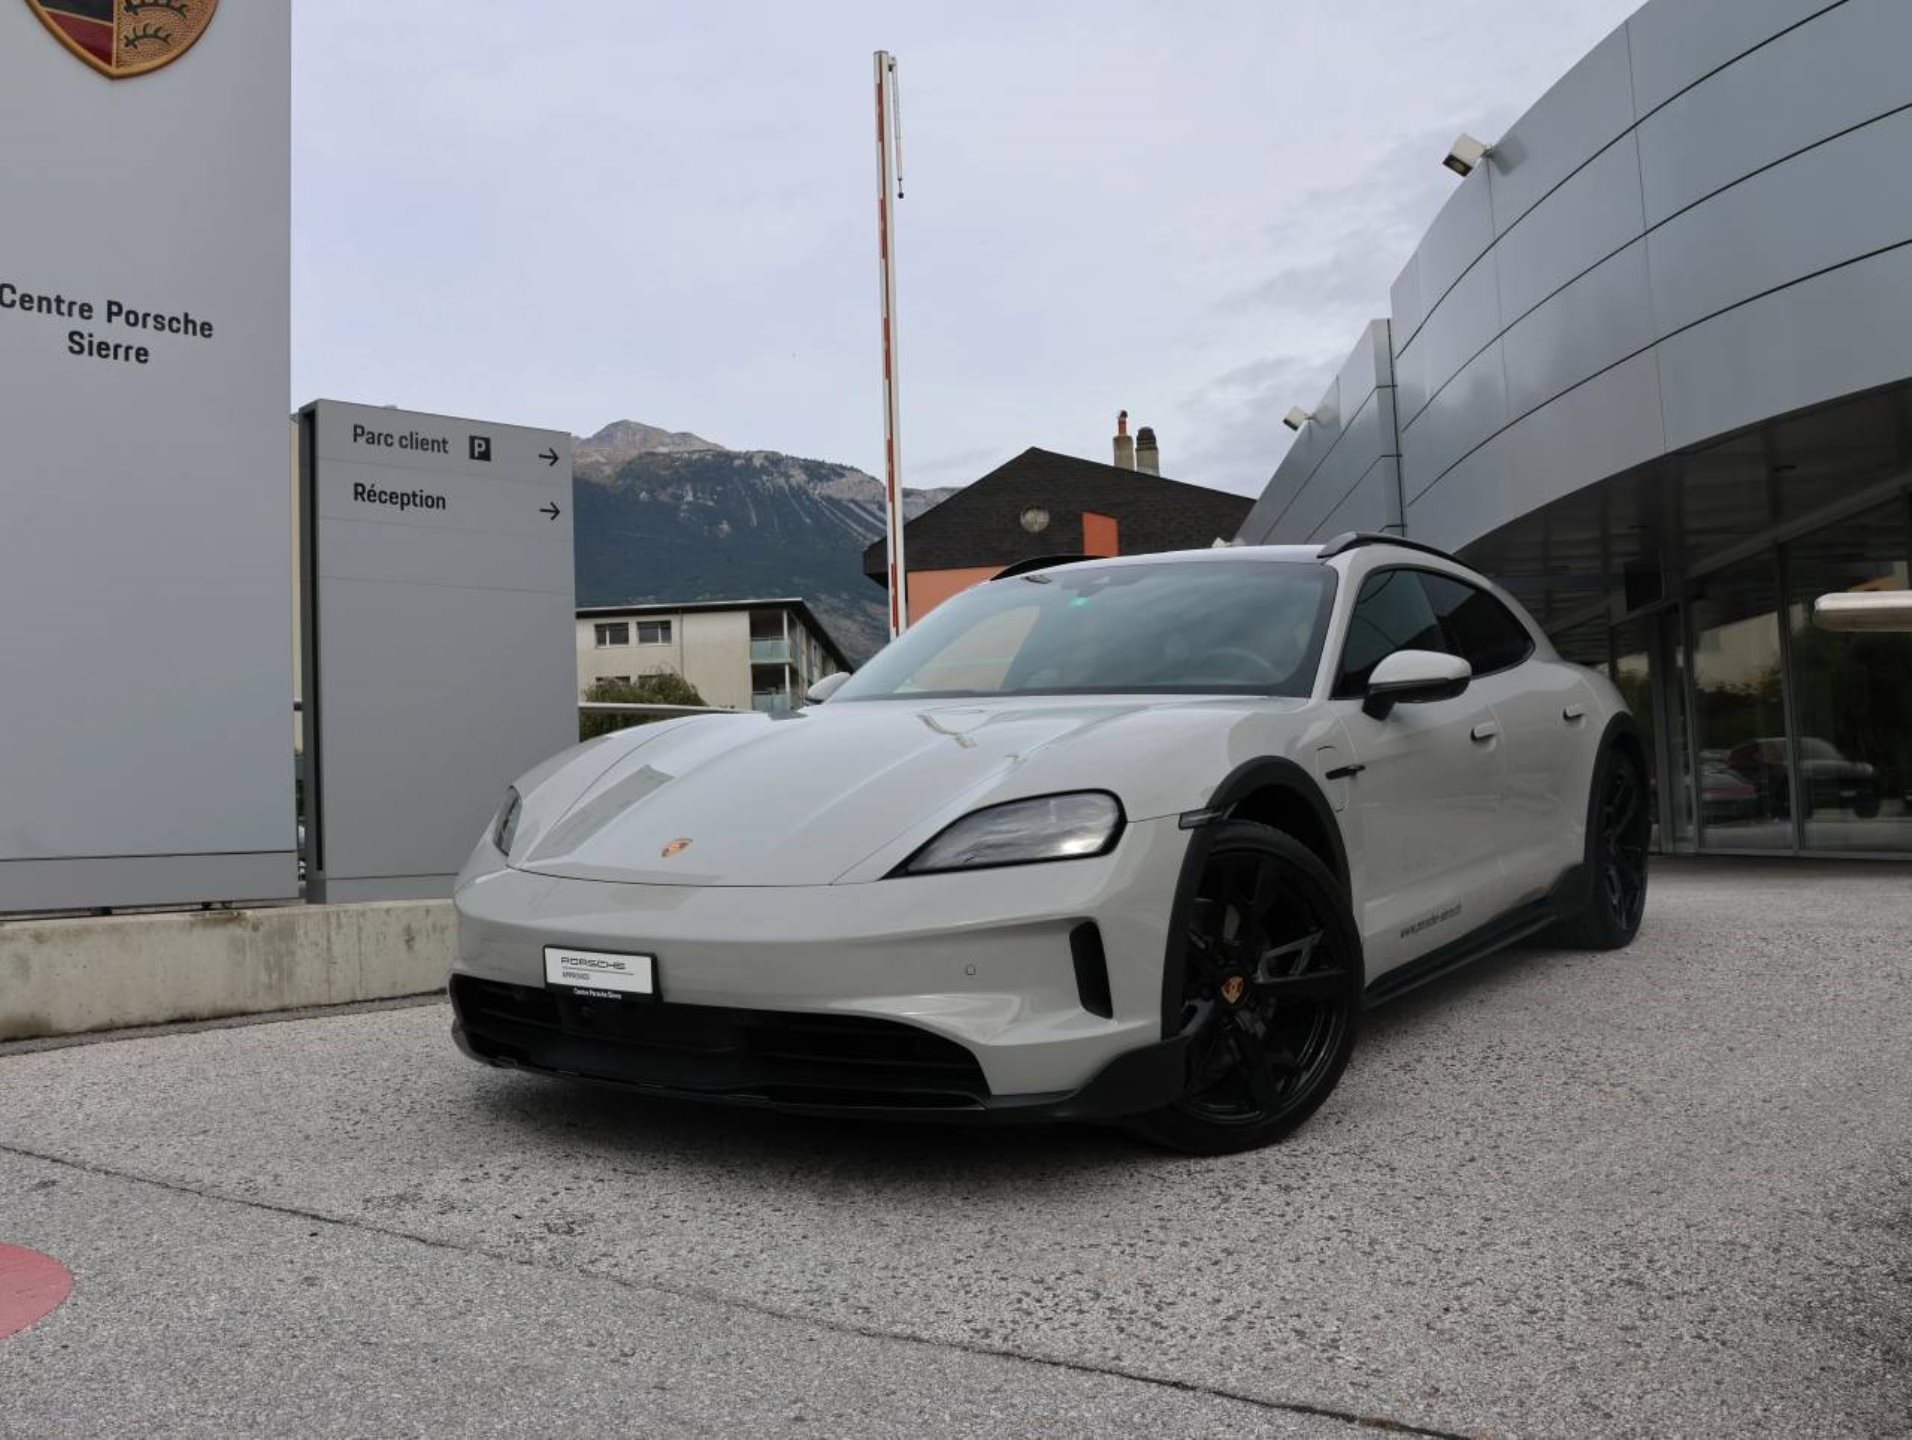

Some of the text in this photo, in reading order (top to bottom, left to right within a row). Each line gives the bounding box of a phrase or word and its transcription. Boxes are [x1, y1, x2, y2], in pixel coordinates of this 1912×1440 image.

[0, 282, 214, 339] Centre Porsche
[67, 330, 149, 364] Sierre
[353, 423, 394, 447] Parc
[398, 431, 449, 454] client
[353, 482, 446, 511] Réception
[561, 957, 626, 970] PORSCHE
